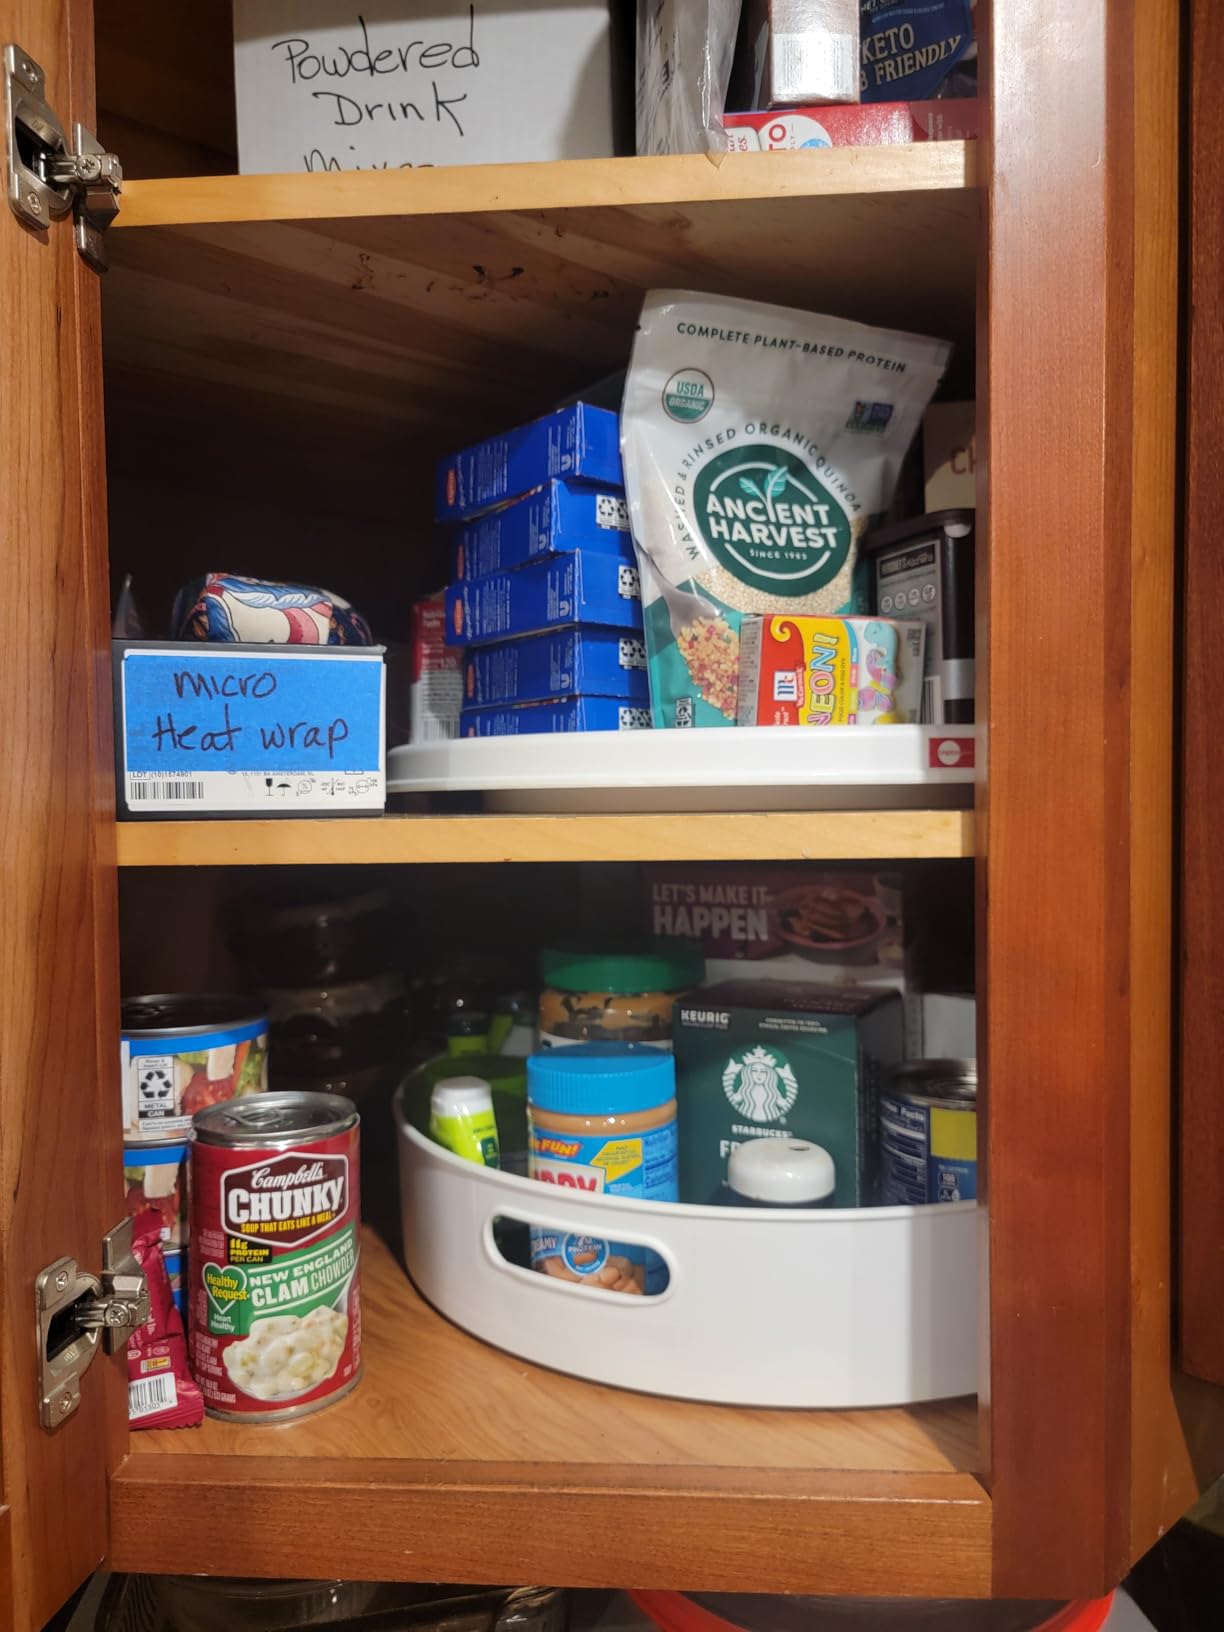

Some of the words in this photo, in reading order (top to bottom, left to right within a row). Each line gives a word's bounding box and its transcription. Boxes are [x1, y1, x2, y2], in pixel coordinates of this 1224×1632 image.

[272, 4, 480, 83] Powdered
[862, 23, 914, 64] KETO
[874, 35, 962, 85] FRIENDLY
[313, 81, 467, 136] Drink
[677, 322, 749, 345] COMPLETE
[753, 335, 844, 359] PLANT-BASED
[848, 350, 907, 374] PROTEIN
[677, 381, 704, 397] USDA
[669, 397, 705, 411] ORGANIC
[682, 428, 736, 469] RINSED
[745, 423, 817, 457] ORGANIC
[816, 456, 862, 513] QUINOA
[706, 493, 830, 525] ANCIENT
[709, 517, 837, 548] HARVEST
[750, 550, 781, 559] SINCE
[152, 703, 242, 752] Heat
[260, 718, 348, 759] wrap
[653, 884, 696, 901] LET'S
[700, 885, 748, 905] MAKE
[653, 904, 768, 941] HAPPEN
[681, 1009, 729, 1024] KEURIG
[731, 1124, 789, 1138] STARBUCKS
[541, 1139, 581, 1157] FUN!
[251, 1162, 324, 1190] Campbell's
[227, 1176, 344, 1225] CHUNKY
[240, 1222, 259, 1233] SOUP
[260, 1222, 277, 1232] THAT
[279, 1221, 295, 1231] EATS
[296, 1219, 310, 1229] LIKE
[311, 1217, 316, 1226] A
[316, 1211, 332, 1225] MEAL
[230, 1249, 269, 1257] PROTEIN
[250, 1270, 288, 1287] NEW
[293, 1239, 353, 1277] ENGLAND
[207, 1273, 239, 1289] Healthy
[252, 1277, 309, 1307] CLAM
[311, 1249, 355, 1290] CHOWDER
[213, 1286, 247, 1301] Request
[211, 1320, 235, 1333] Healthy
[213, 1313, 232, 1323] Heart
